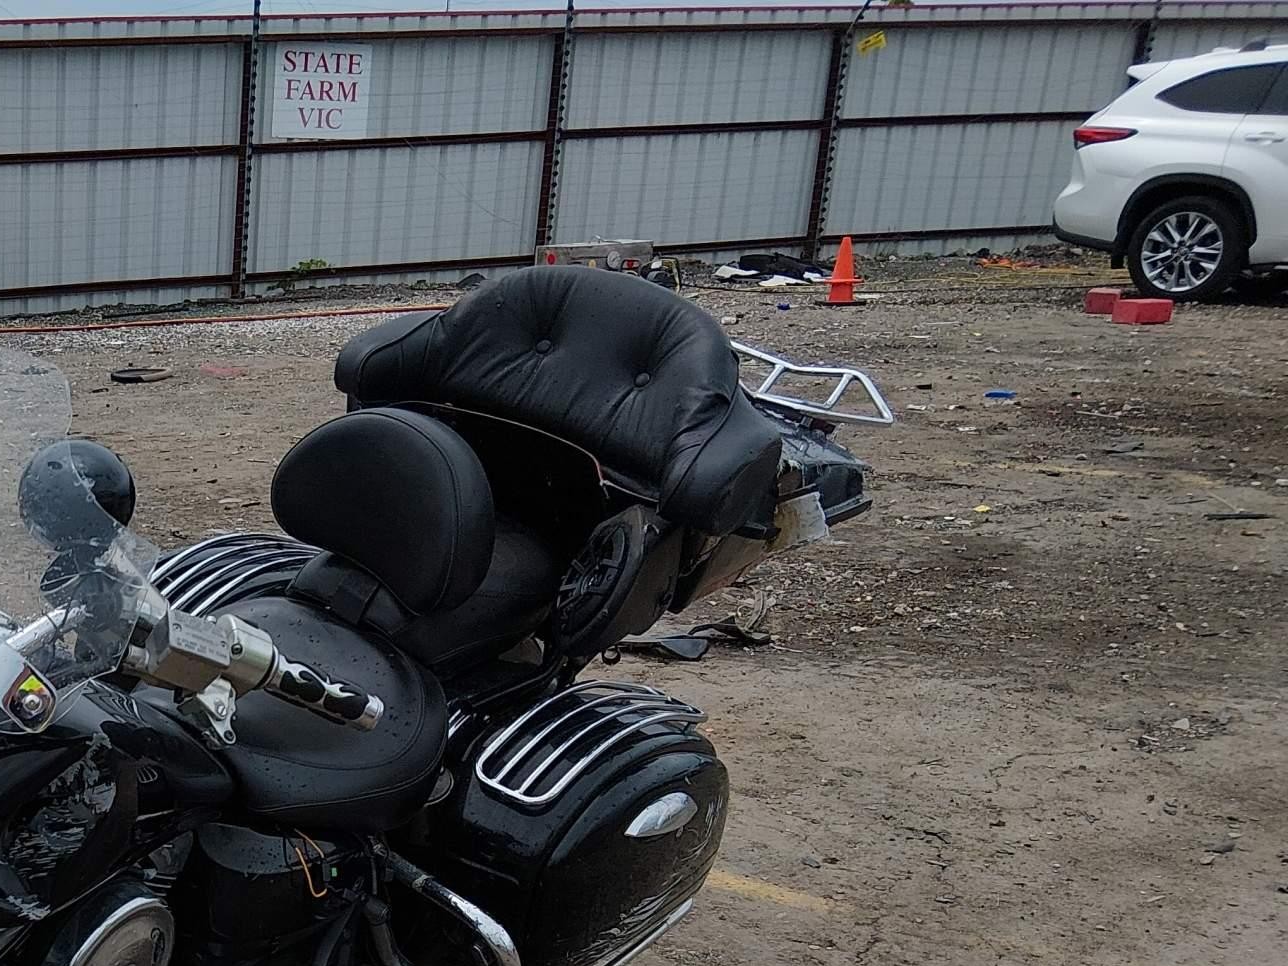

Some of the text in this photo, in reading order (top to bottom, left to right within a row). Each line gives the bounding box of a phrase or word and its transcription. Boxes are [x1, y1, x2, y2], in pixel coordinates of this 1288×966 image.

[283, 49, 364, 75] STATE
[284, 78, 359, 103] FARM
[297, 107, 343, 129] VIC
